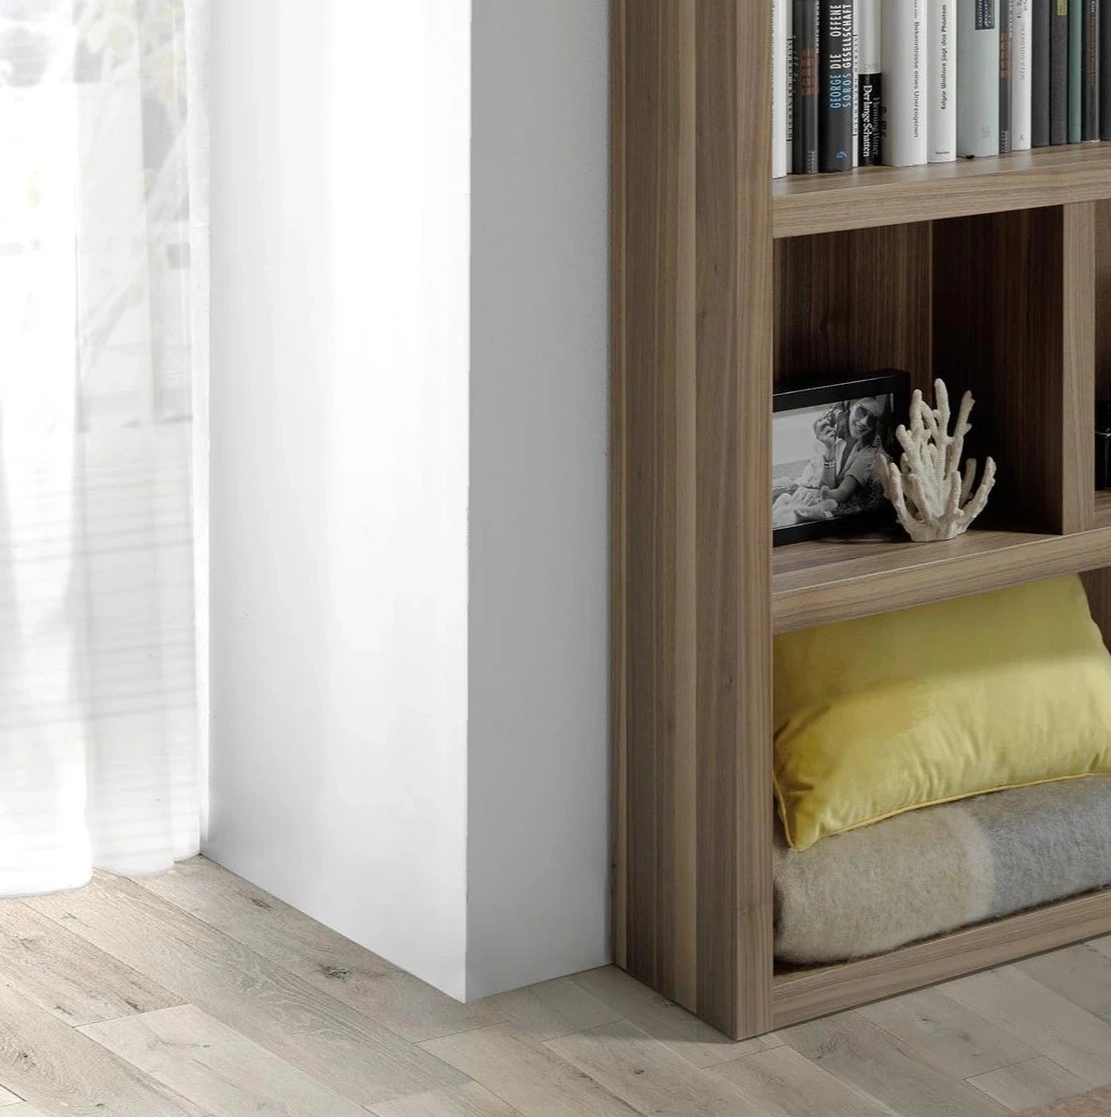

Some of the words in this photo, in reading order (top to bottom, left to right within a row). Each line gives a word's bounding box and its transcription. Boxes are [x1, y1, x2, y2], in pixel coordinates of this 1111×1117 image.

[829, 4, 842, 37] OFFENE
[940, 4, 948, 33] Phantom
[843, 4, 852, 69] GESELLSCHAFT
[829, 54, 842, 70] DIE
[940, 47, 948, 61] jagt
[843, 73, 852, 108] SOROS
[940, 62, 948, 89] Wallace
[829, 74, 842, 109] GEORGE
[863, 84, 872, 102] Der
[940, 90, 948, 110] Edgar
[861, 102, 872, 122] lange
[871, 97, 881, 132] Henning
[912, 90, 920, 138] Unerzogenen
[863, 122, 872, 157] Schatten
